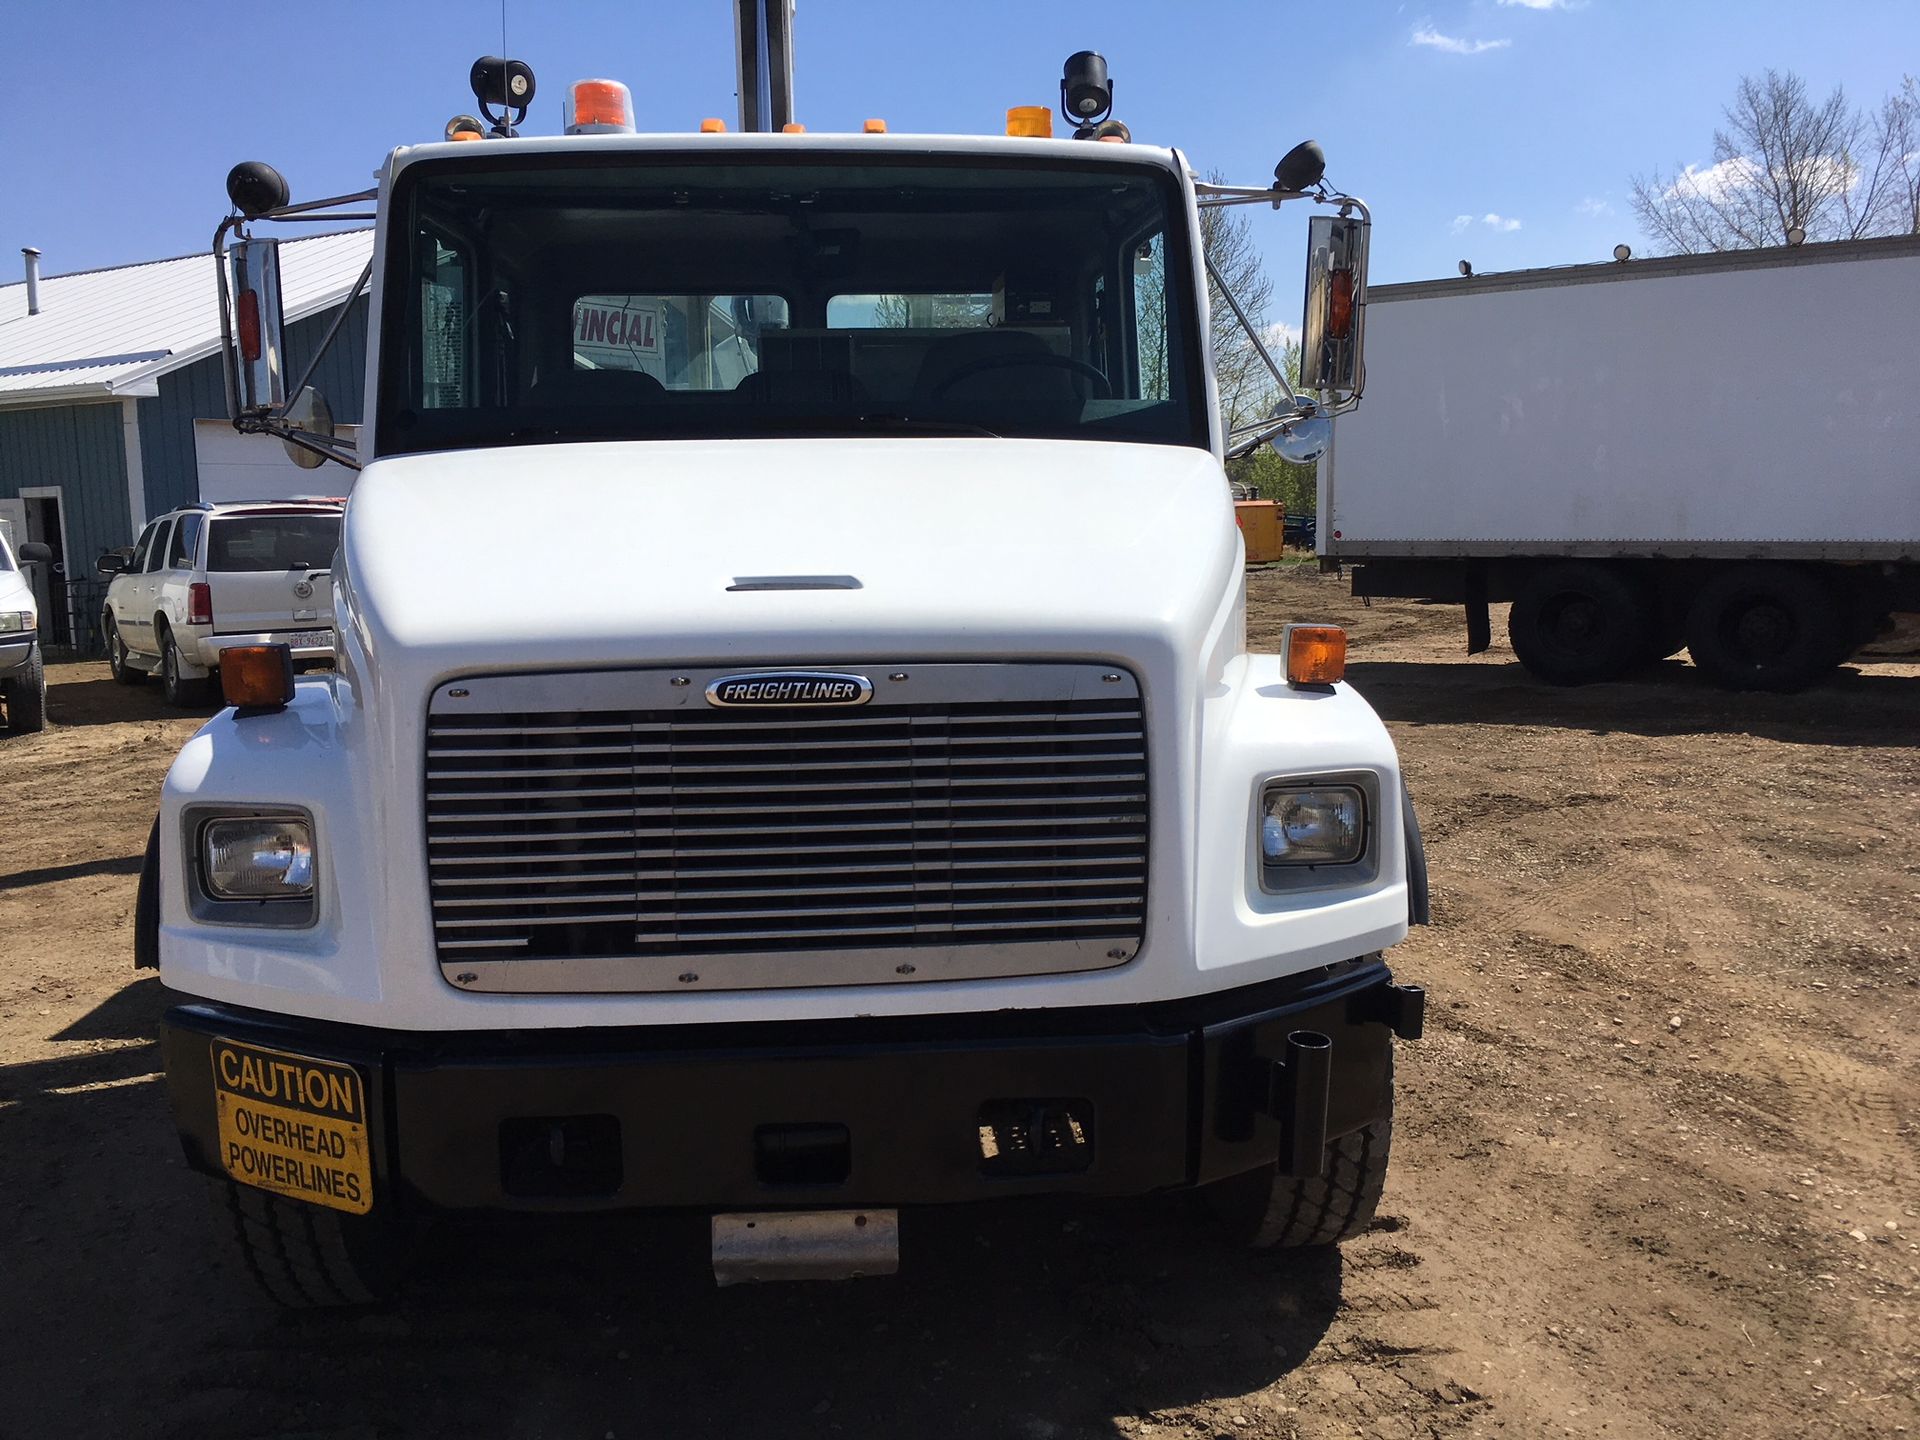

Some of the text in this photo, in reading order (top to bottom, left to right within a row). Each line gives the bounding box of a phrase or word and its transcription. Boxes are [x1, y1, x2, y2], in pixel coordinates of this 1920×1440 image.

[723, 682, 855, 699] FREIGHTLINER
[219, 1049, 353, 1114] CAUTION
[236, 1107, 345, 1159] OVERHEAD
[229, 1142, 361, 1202] POWERLINES
